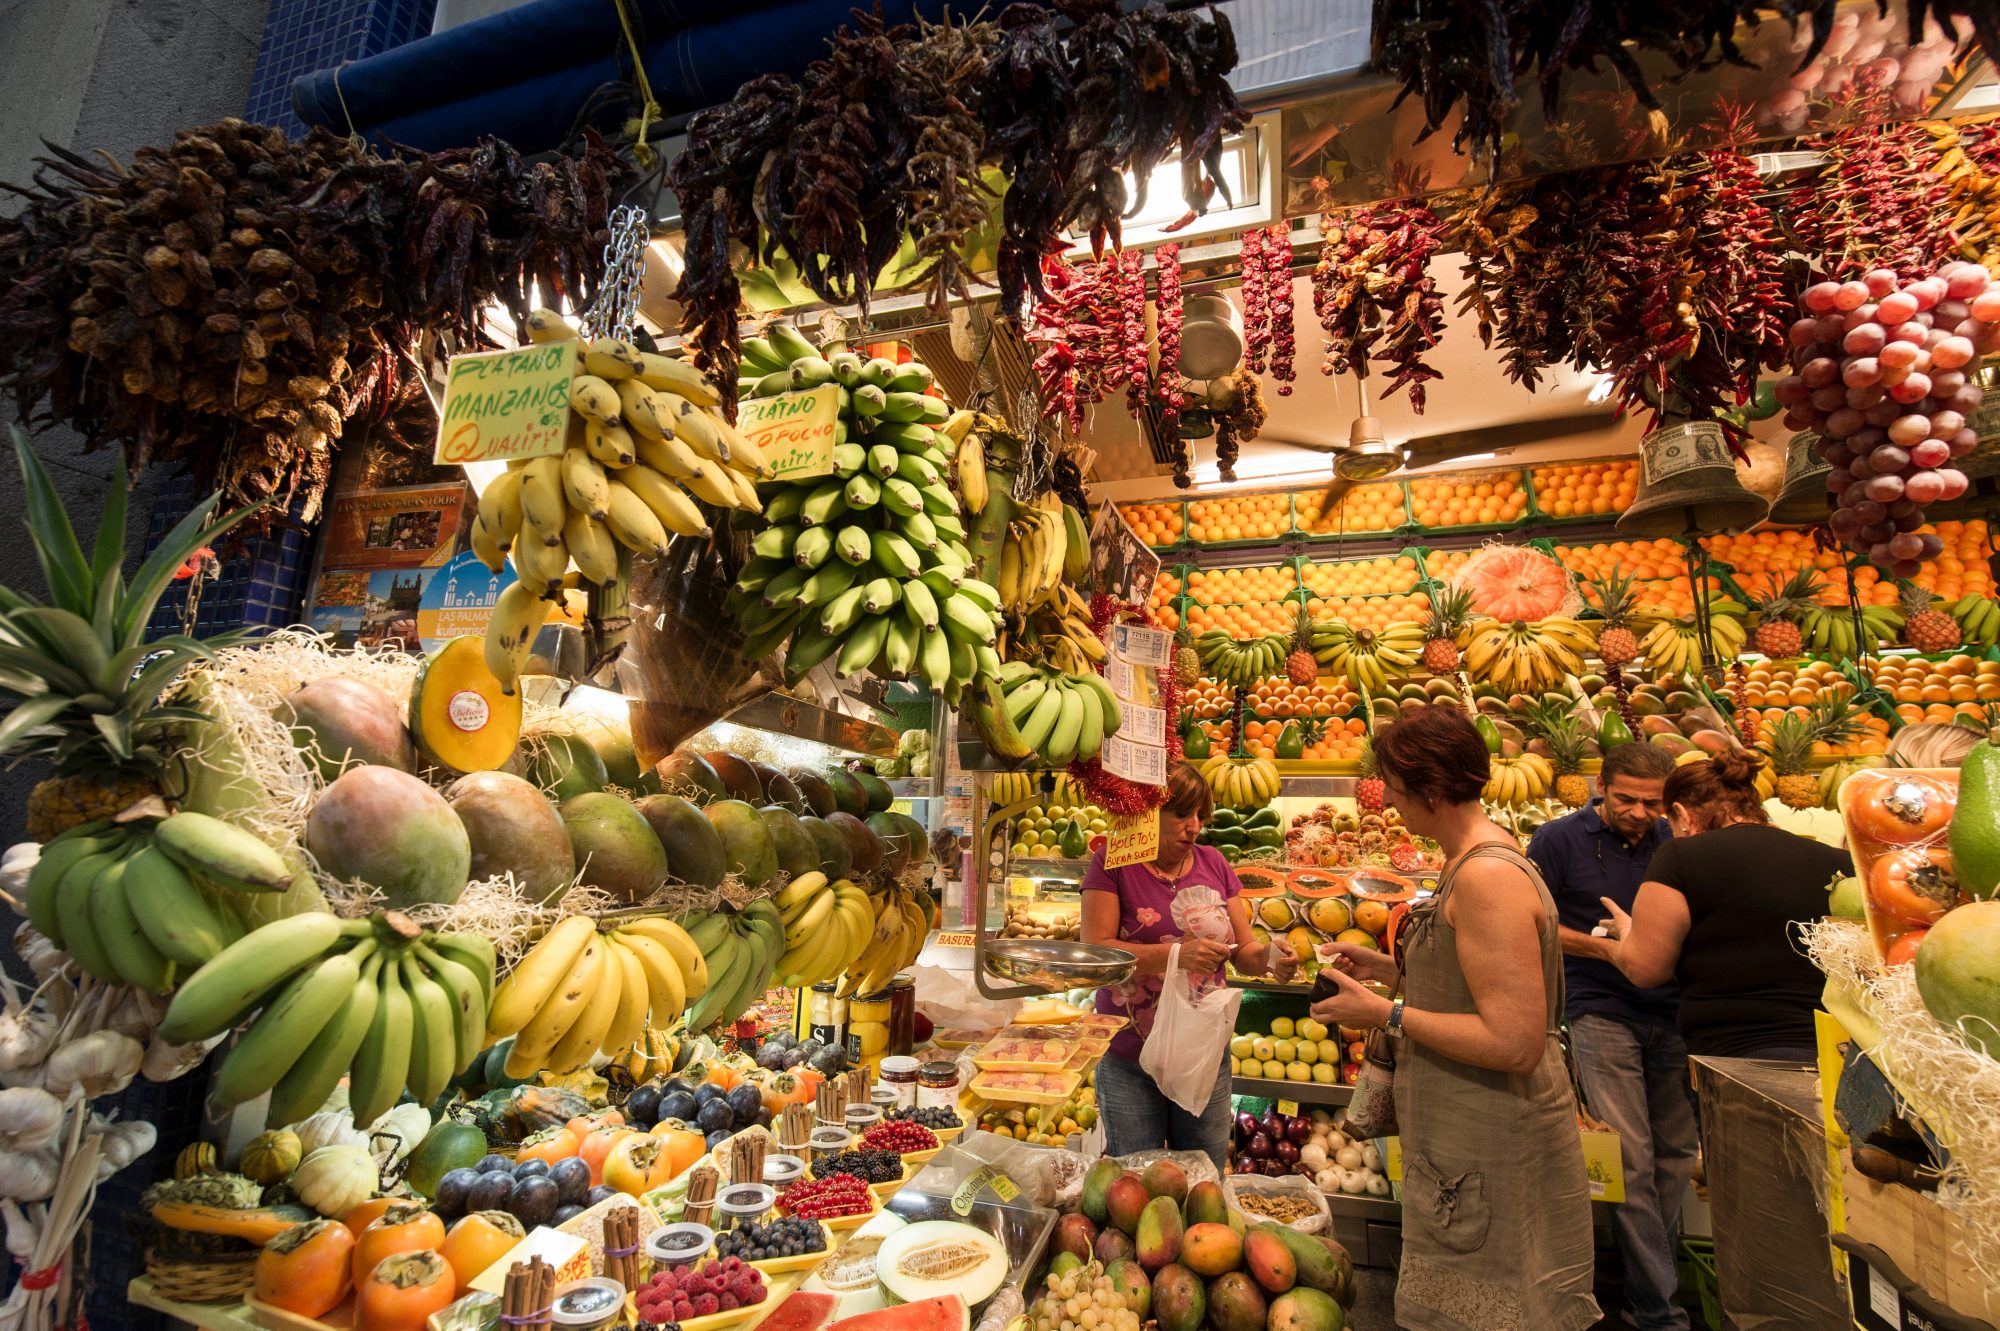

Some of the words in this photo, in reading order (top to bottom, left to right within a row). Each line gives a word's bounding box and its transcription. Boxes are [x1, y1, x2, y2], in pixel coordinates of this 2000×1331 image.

[444, 377, 570, 427] MANZANOS
[428, 495, 456, 505] TOUR
[439, 611, 455, 622] LAS
[435, 622, 488, 637] kulinarisc
